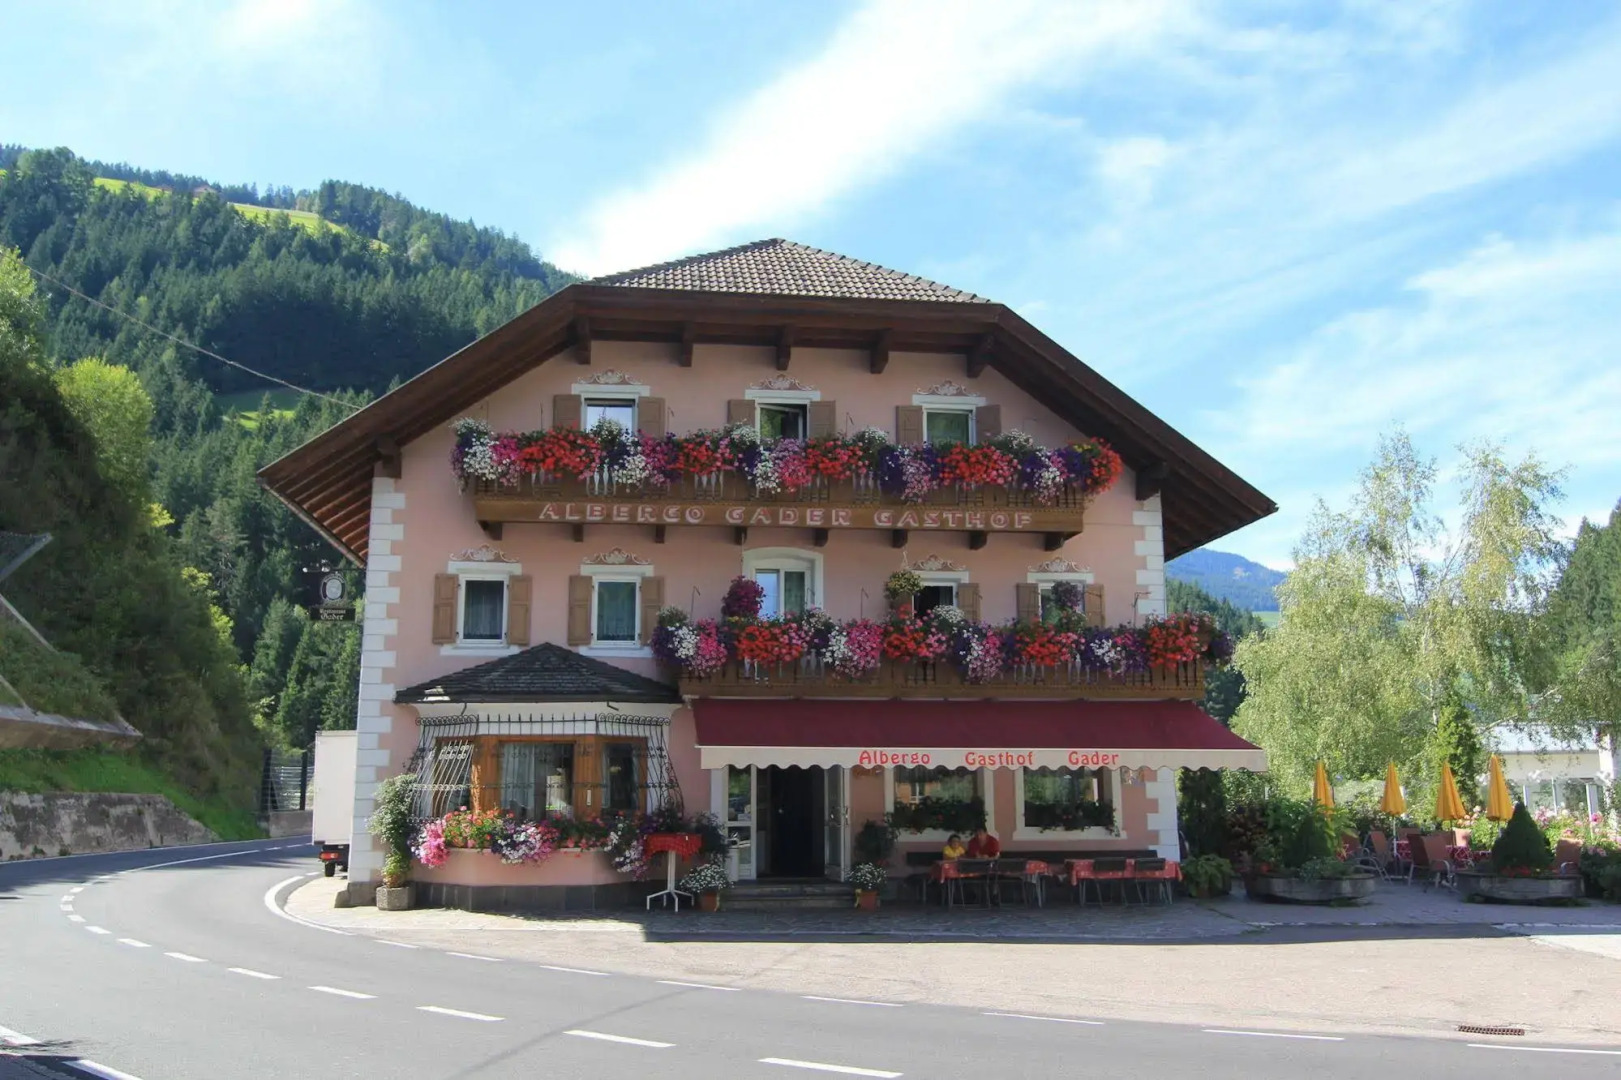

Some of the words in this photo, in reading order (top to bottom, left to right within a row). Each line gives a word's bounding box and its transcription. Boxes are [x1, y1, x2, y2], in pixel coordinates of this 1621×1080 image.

[539, 503, 705, 524] ALBERGO
[725, 506, 852, 526] GADER
[874, 509, 1033, 529] GASTHOF
[859, 750, 931, 766] Albergo
[964, 750, 1034, 767] Gasthof
[1068, 750, 1120, 767] Gader
